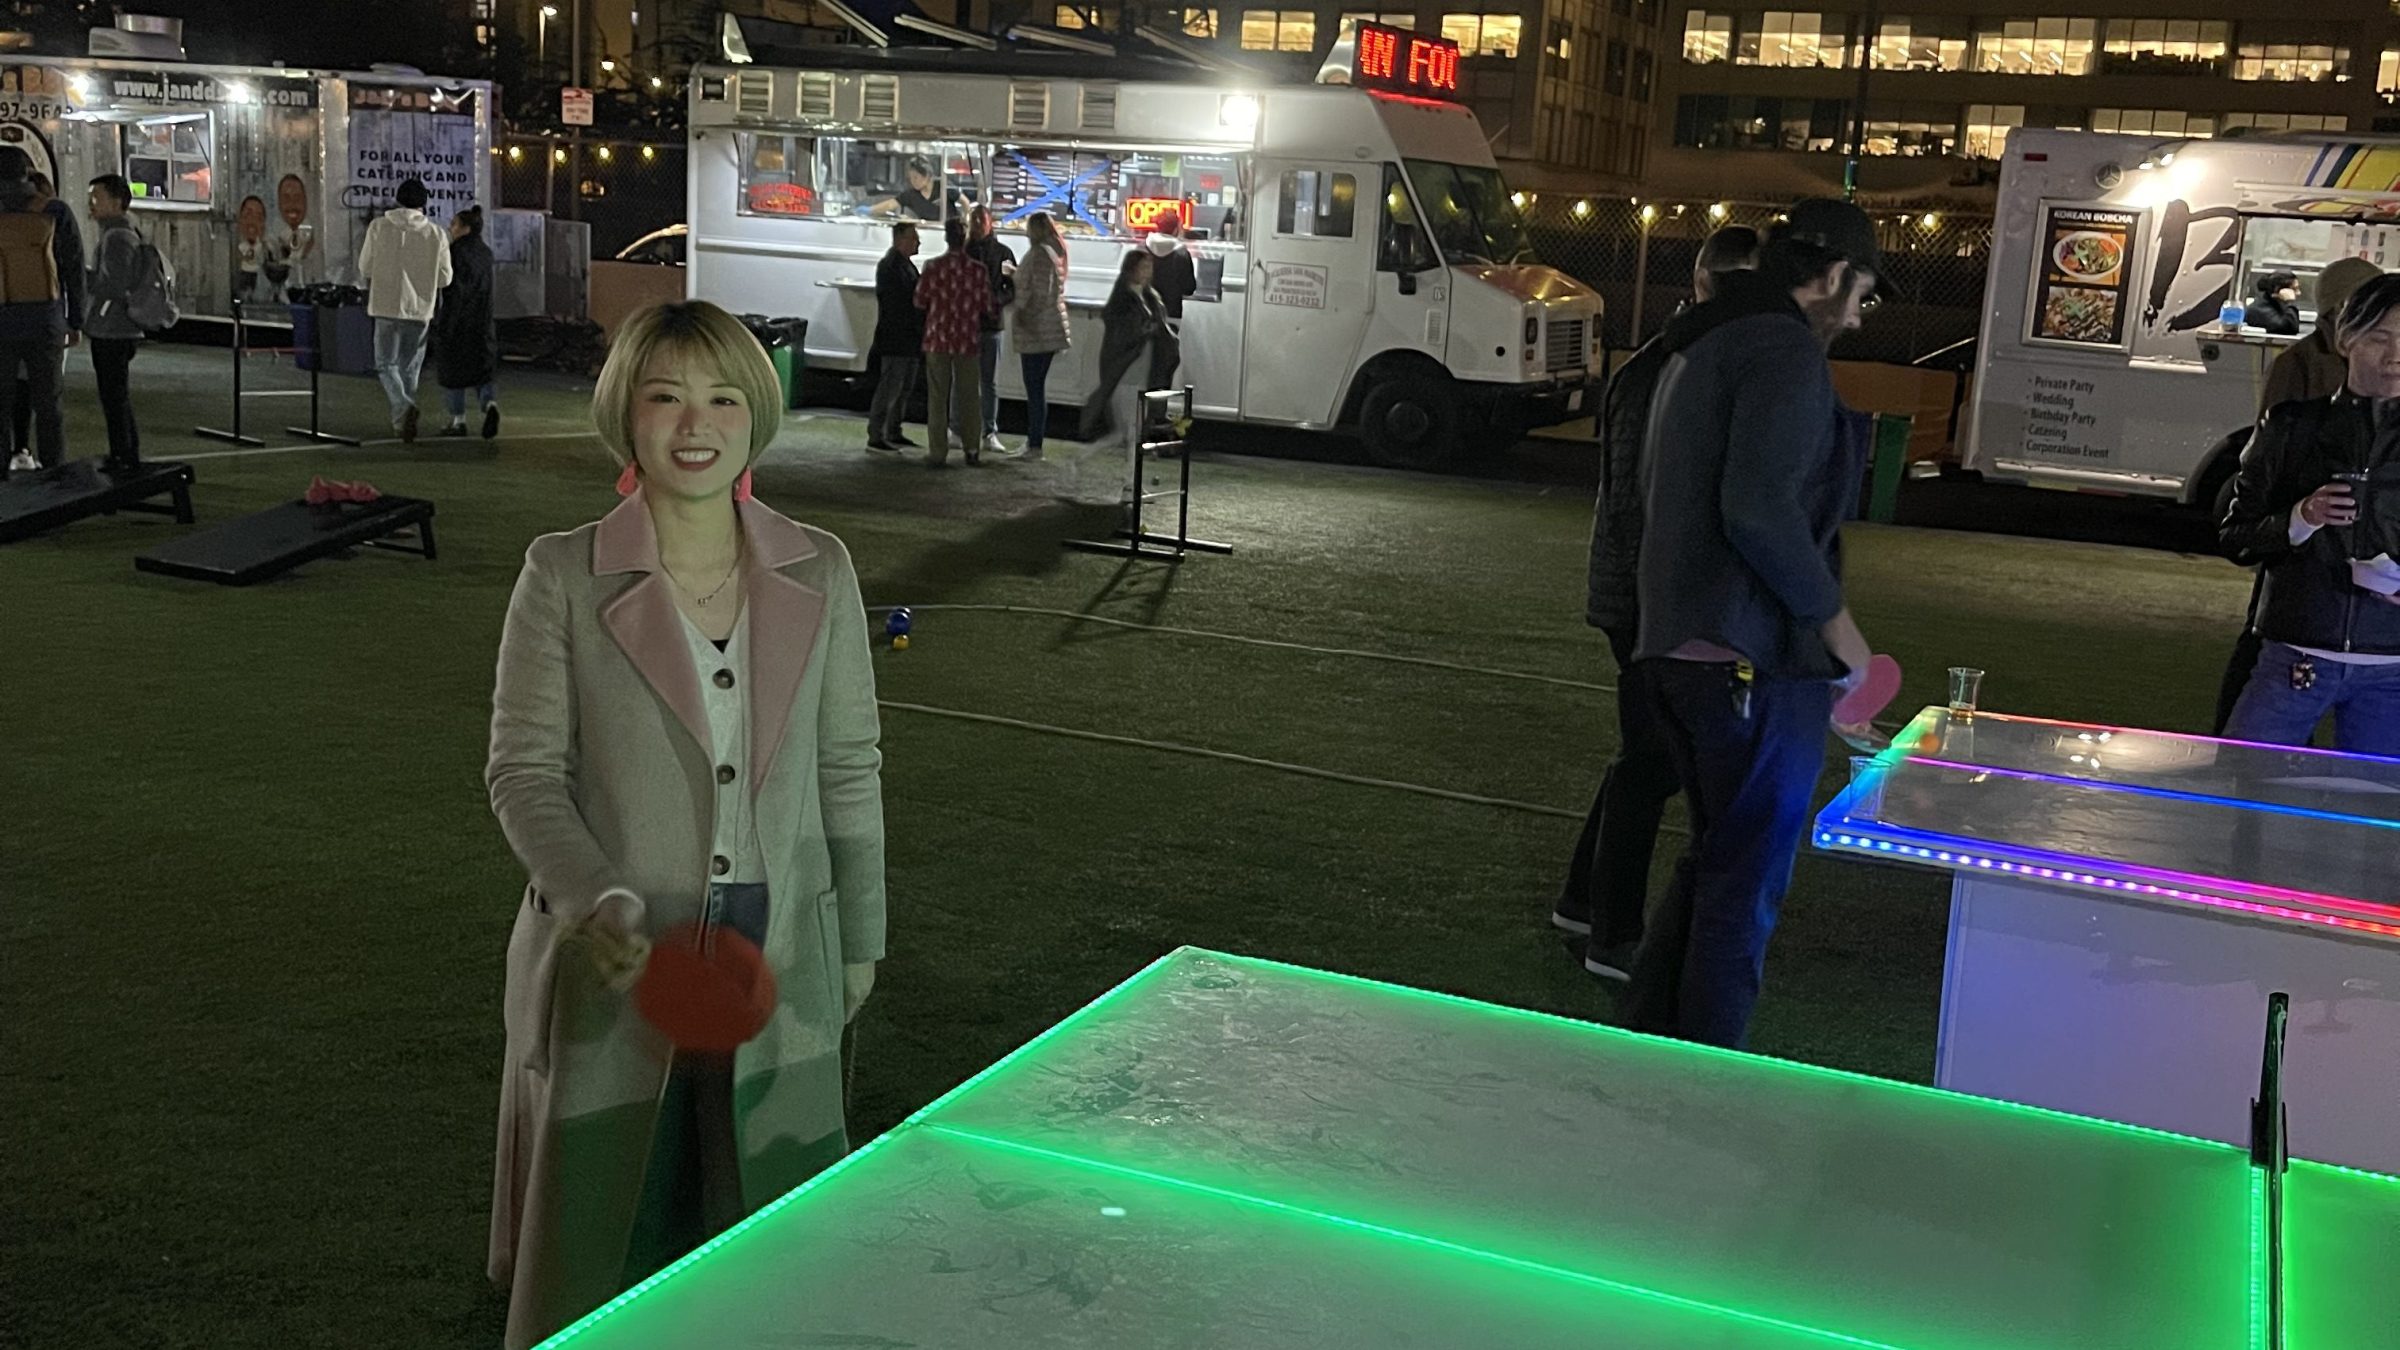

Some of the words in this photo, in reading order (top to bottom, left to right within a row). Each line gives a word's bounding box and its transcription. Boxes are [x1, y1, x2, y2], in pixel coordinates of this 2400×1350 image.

[360, 150, 389, 162] FOR
[393, 151, 420, 164] ALL
[424, 154, 464, 166] YOUR
[357, 168, 431, 181] CATERING
[435, 172, 467, 184] AND
[427, 189, 474, 201] VENTS
[2054, 210, 2092, 221] KOREAN
[2034, 376, 2068, 390] Private
[2070, 379, 2095, 395] Party
[2033, 392, 2074, 410] Wedding
[2031, 408, 2070, 425] Birthday
[2072, 411, 2096, 427] Party
[2028, 424, 2067, 441] Catering
[2026, 440, 2081, 455] Corporation
[2083, 445, 2109, 458] Event
